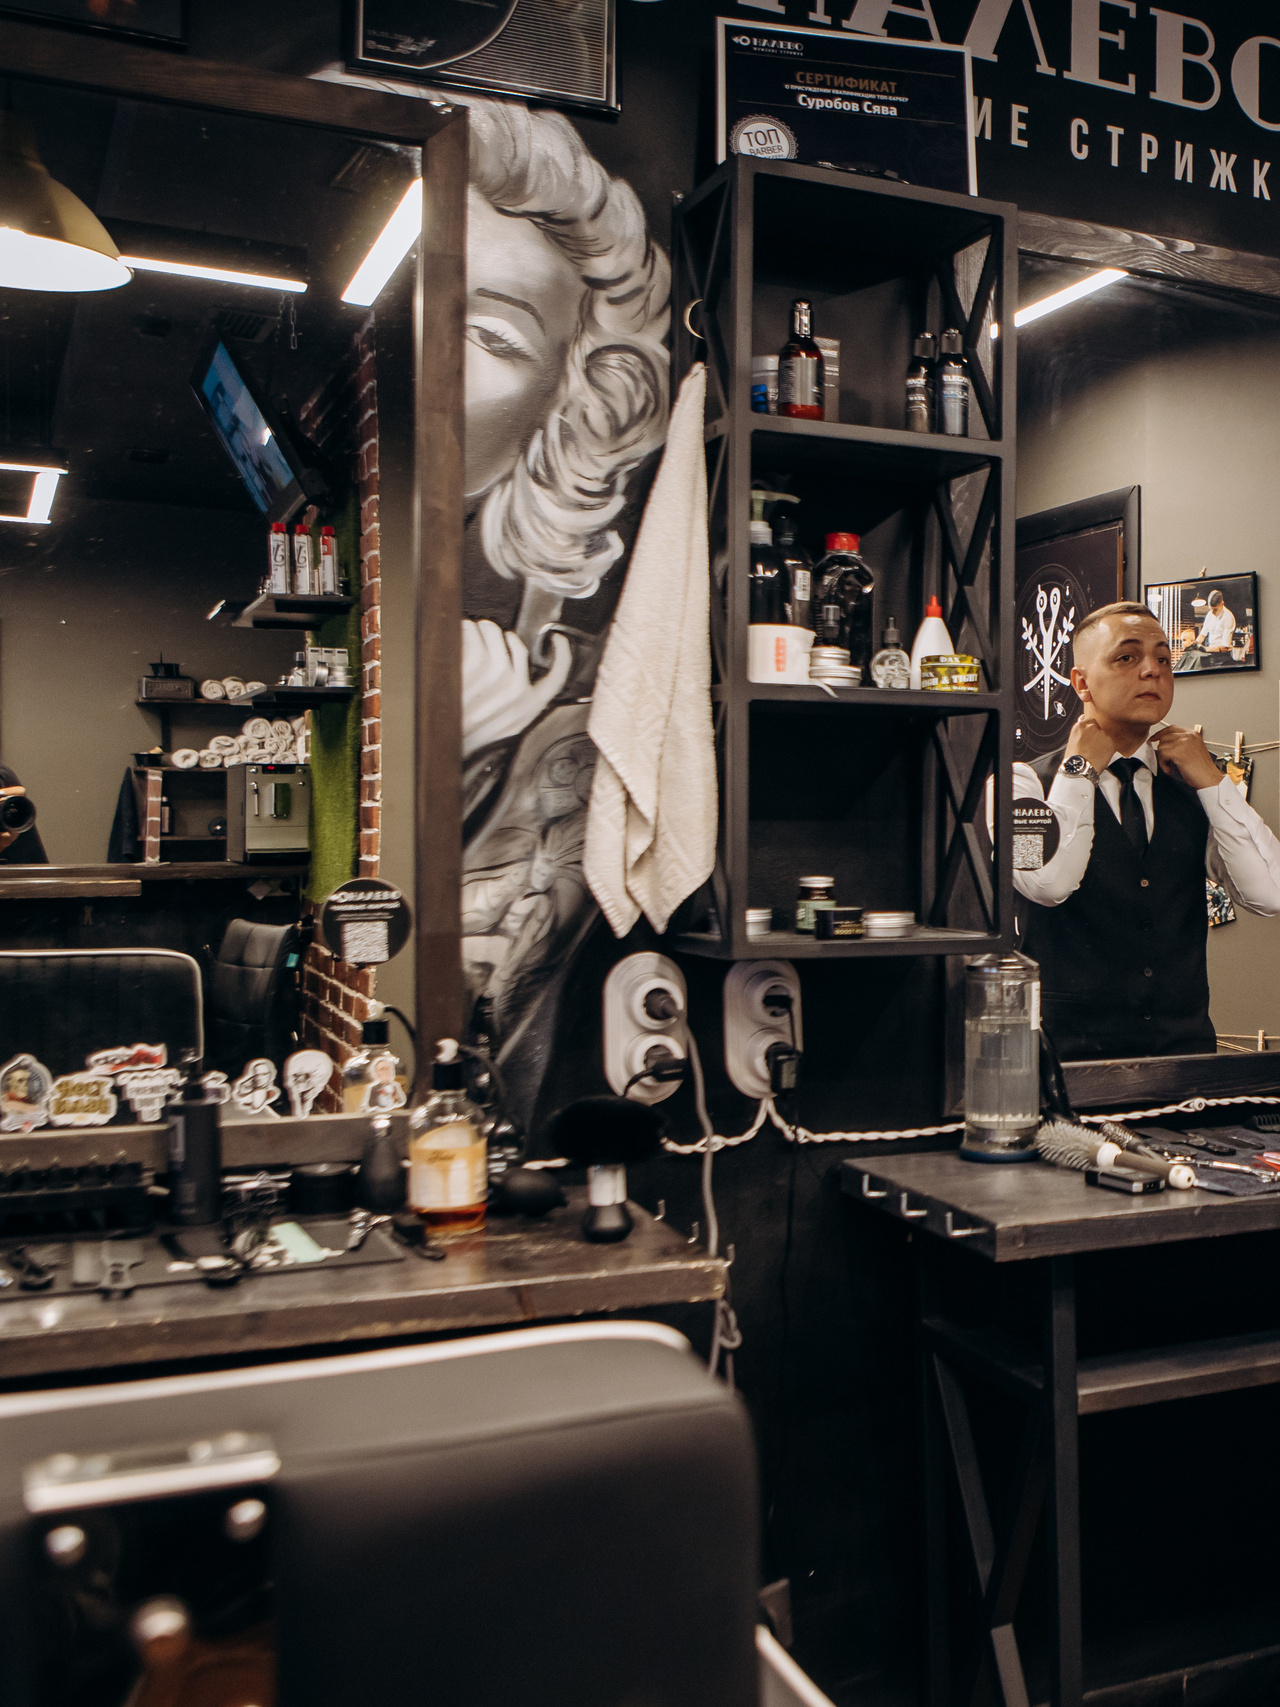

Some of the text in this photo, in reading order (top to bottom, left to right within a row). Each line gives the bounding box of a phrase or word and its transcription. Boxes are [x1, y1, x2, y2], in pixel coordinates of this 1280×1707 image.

[753, 38, 804, 51] НАЛЕВО
[796, 72, 898, 93] СЕРТИФИКАТ
[798, 94, 898, 116] Суробов Сява
[743, 129, 780, 147] ТОП
[749, 145, 784, 156] BARBER
[941, 676, 950, 684] &
